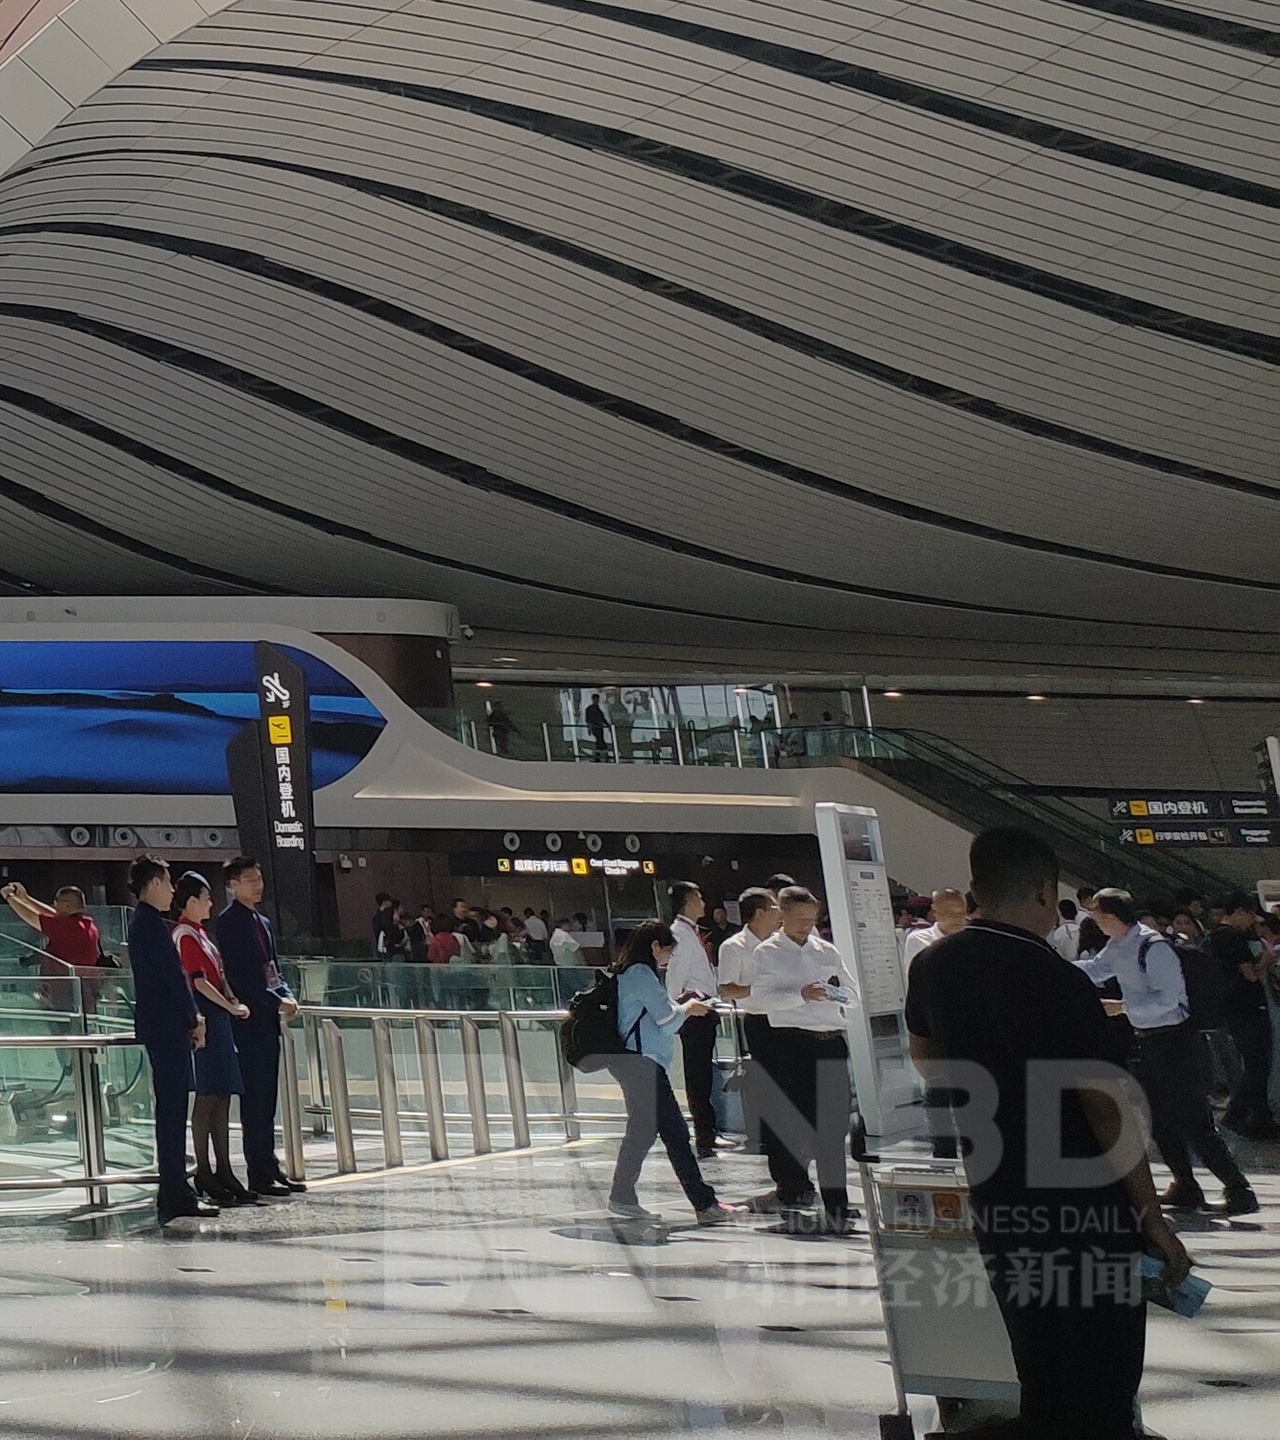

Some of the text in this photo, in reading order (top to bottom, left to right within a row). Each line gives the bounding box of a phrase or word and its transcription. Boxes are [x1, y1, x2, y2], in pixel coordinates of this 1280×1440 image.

[275, 747, 295, 818] 国内登机
[1147, 801, 1208, 815] 国内登机
